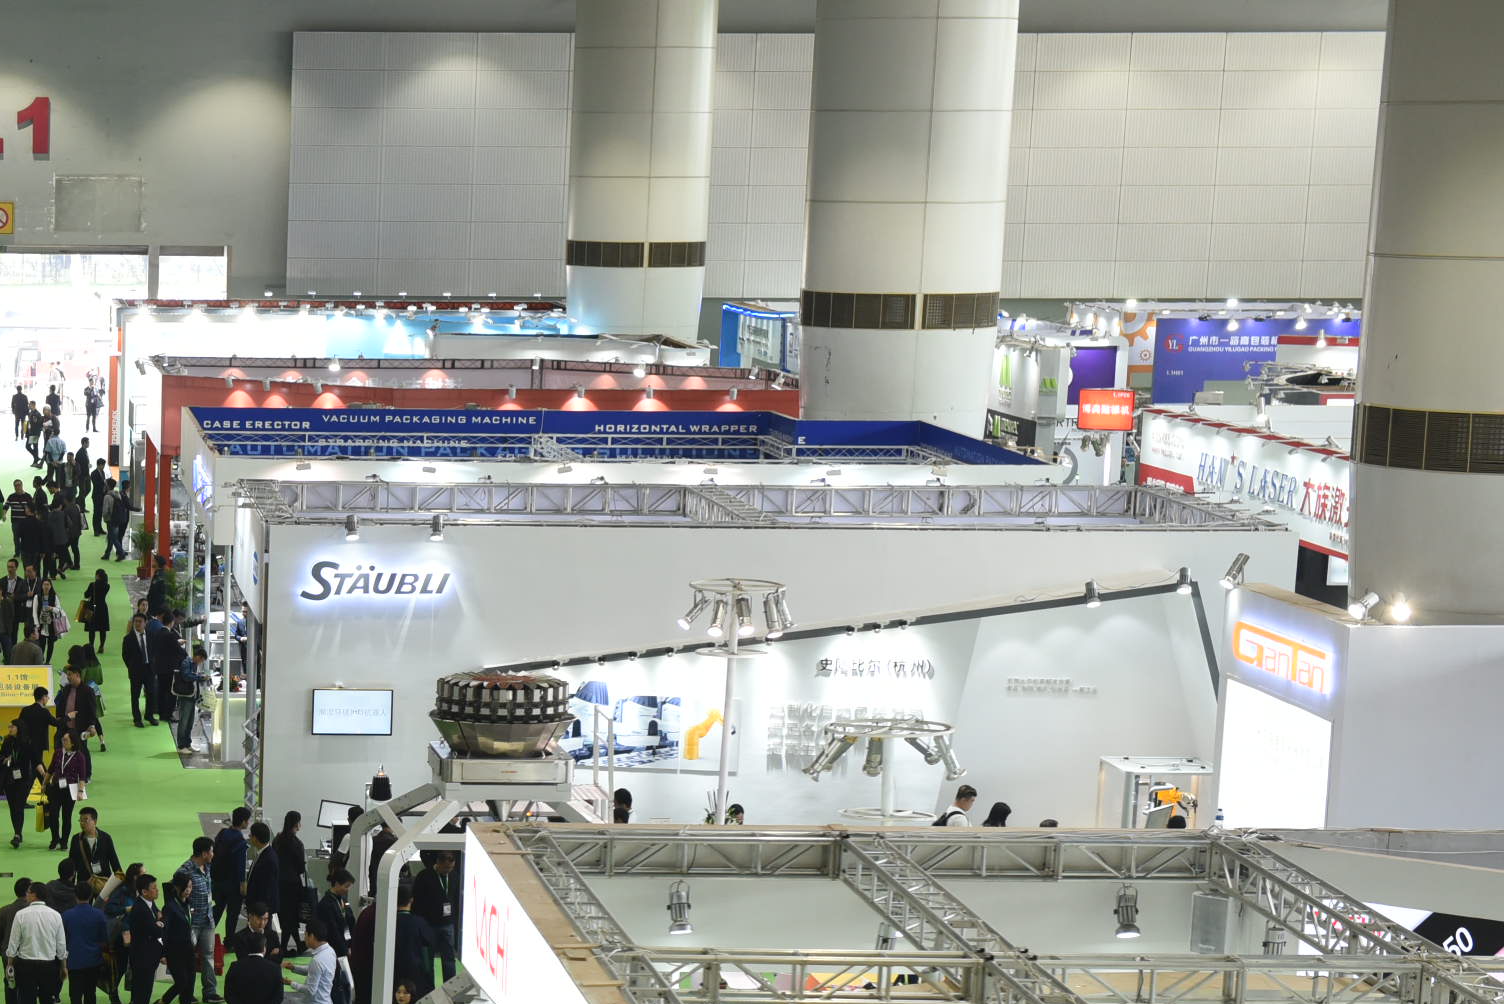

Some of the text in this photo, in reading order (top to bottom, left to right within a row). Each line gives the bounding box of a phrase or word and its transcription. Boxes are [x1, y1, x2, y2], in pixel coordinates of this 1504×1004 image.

[203, 419, 311, 430] CASE ERECTOR
[322, 414, 538, 425] VACUUM PACKAGING MACHINE
[594, 424, 758, 434] HORIZONTAL WRAPPER
[1247, 464, 1298, 510] LASER
[1299, 478, 1350, 528] 大族激
[299, 560, 451, 601] STÄUBLI
